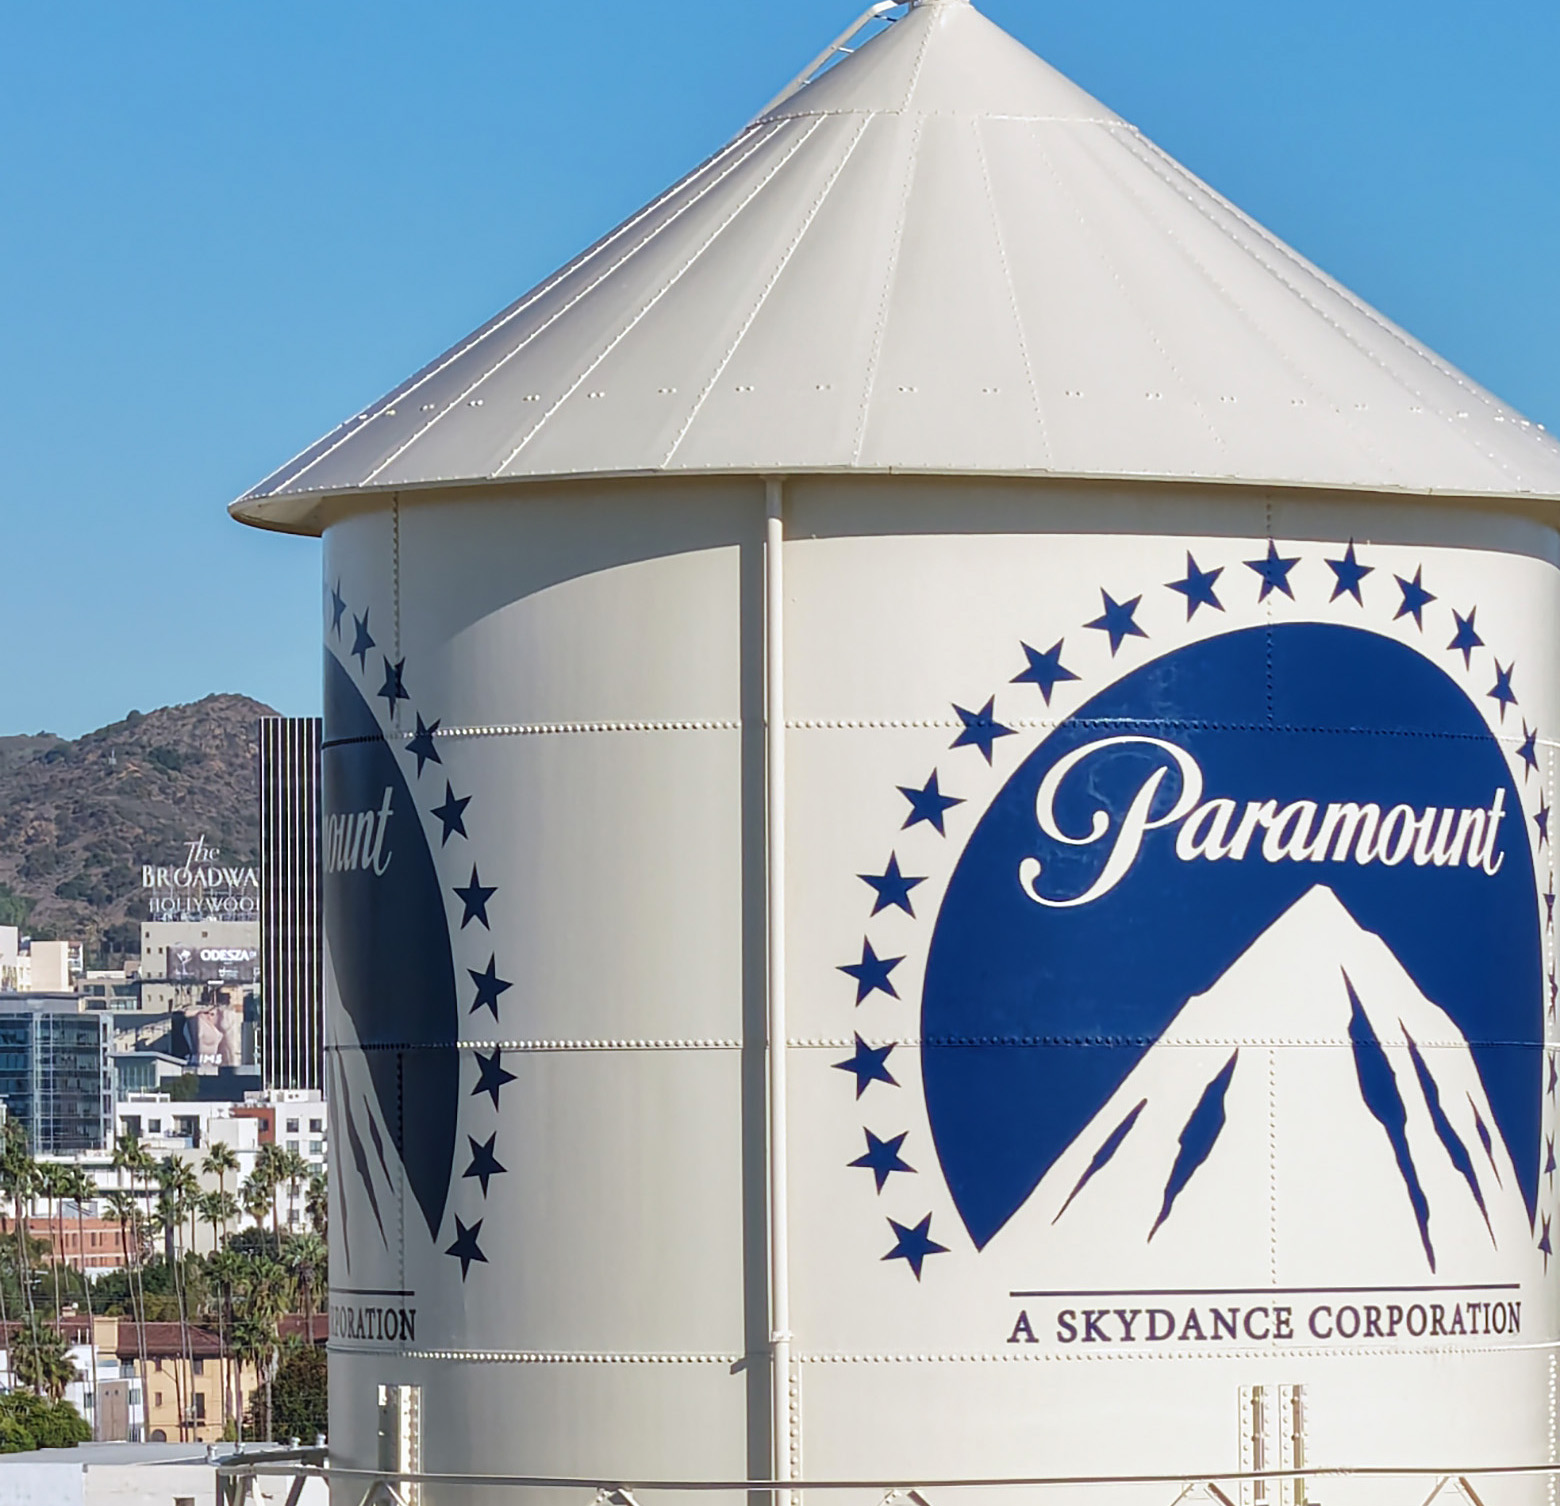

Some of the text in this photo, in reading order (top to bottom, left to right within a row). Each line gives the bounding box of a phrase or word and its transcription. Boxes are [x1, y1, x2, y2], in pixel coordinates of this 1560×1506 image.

[1018, 735, 1506, 908] Paramount
[183, 833, 220, 879] The
[142, 864, 259, 888] BROADWA
[149, 896, 260, 913] HOLLYWOO
[200, 949, 250, 961] ODESZA
[1006, 1301, 1521, 1343] A SKYDANCE CORPORATION
